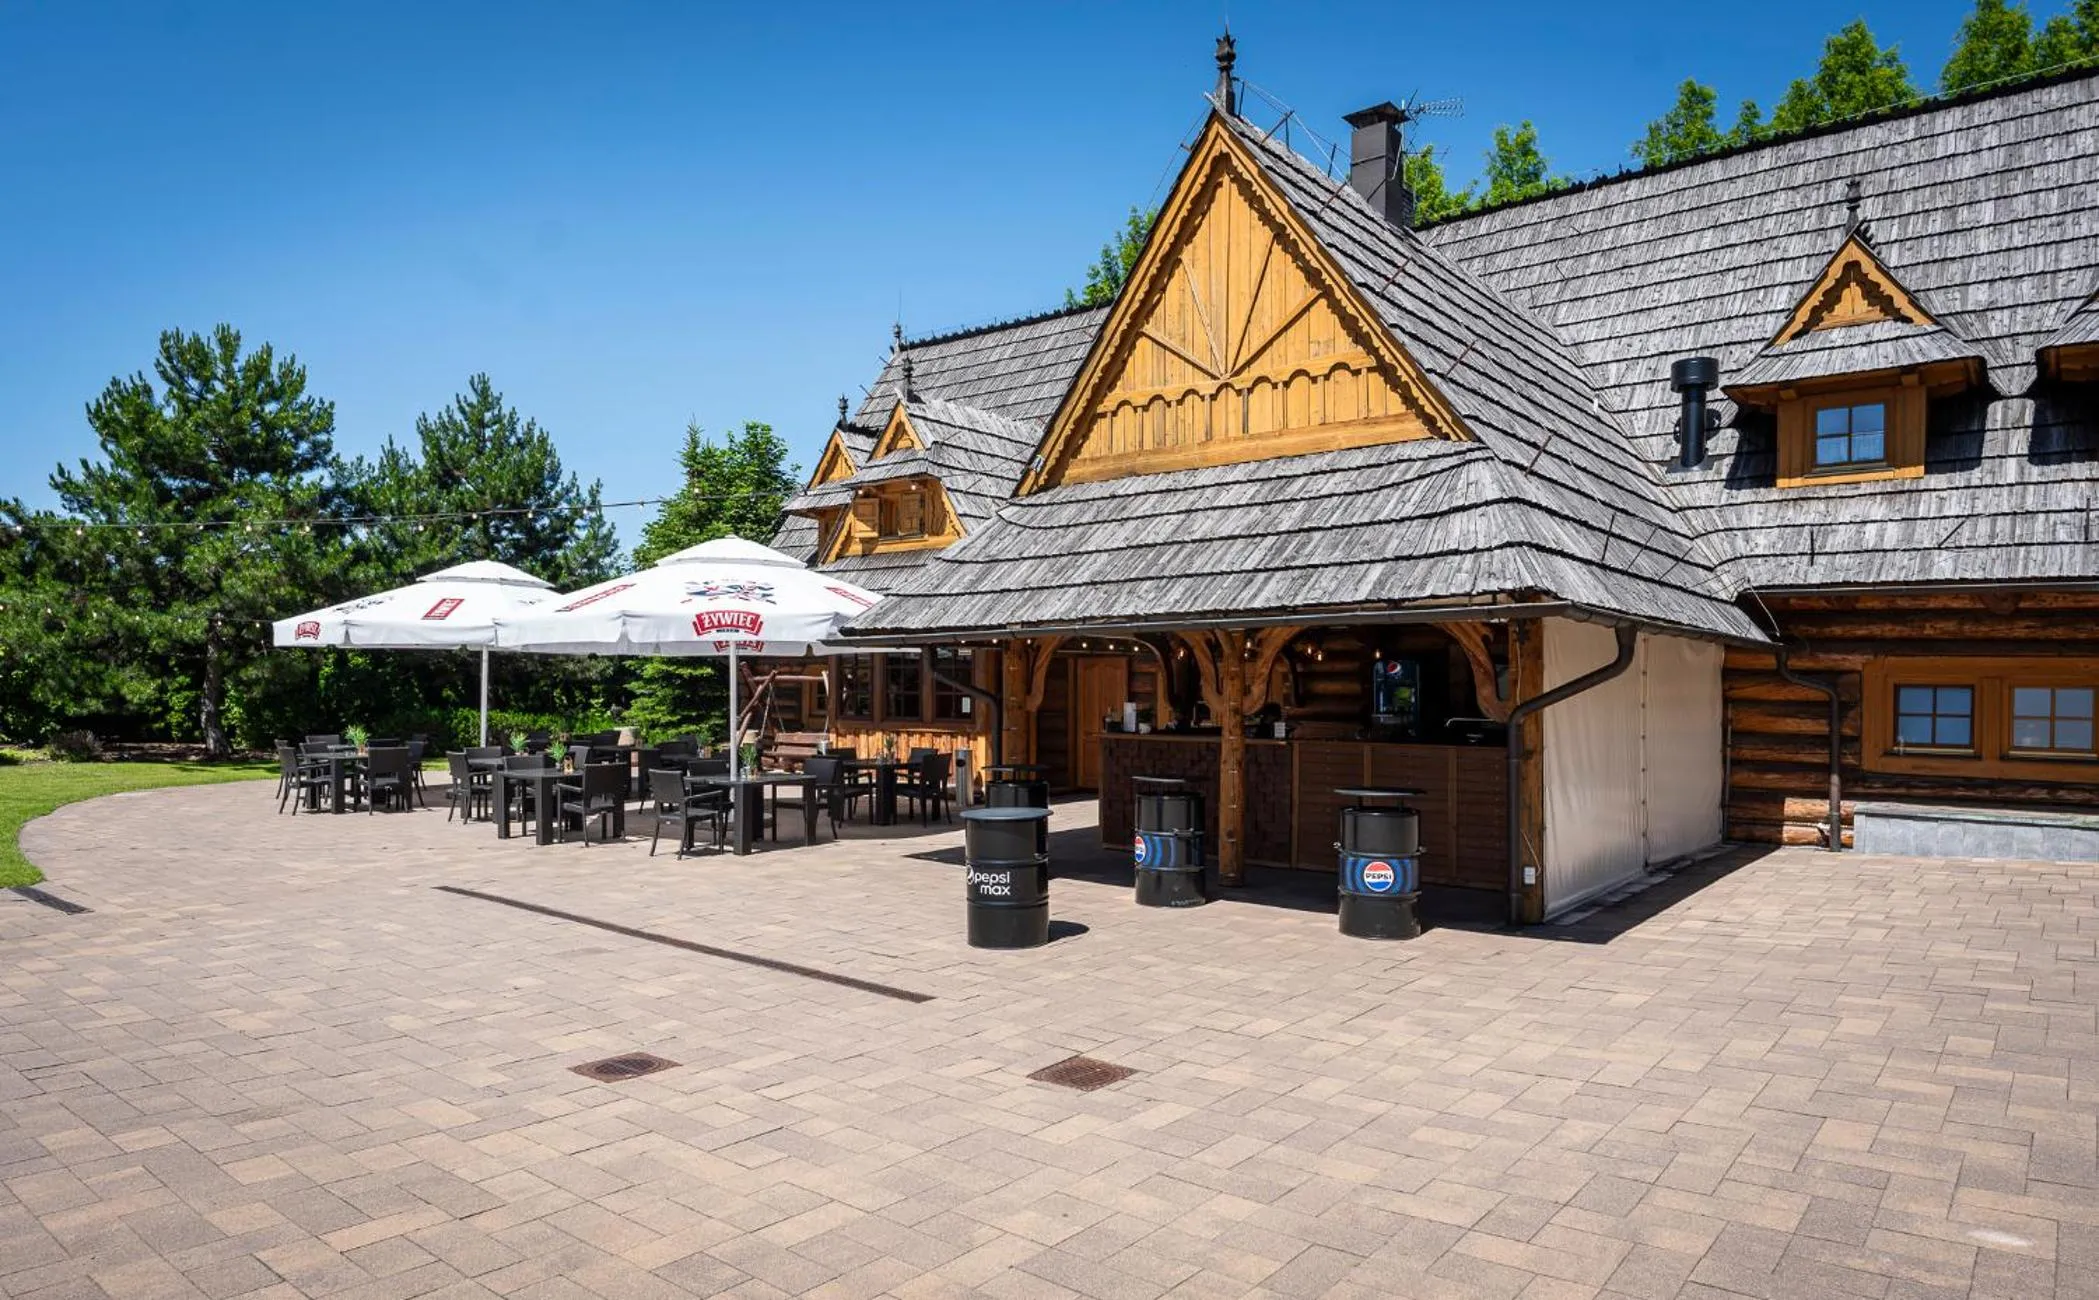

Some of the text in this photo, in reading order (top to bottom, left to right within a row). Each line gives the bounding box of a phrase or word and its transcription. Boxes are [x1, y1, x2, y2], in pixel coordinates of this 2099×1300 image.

[701, 612, 756, 628] ŻYWIEC
[974, 871, 1011, 885] pepsi
[1365, 872, 1392, 880] PEPSI
[980, 884, 1011, 896] max
